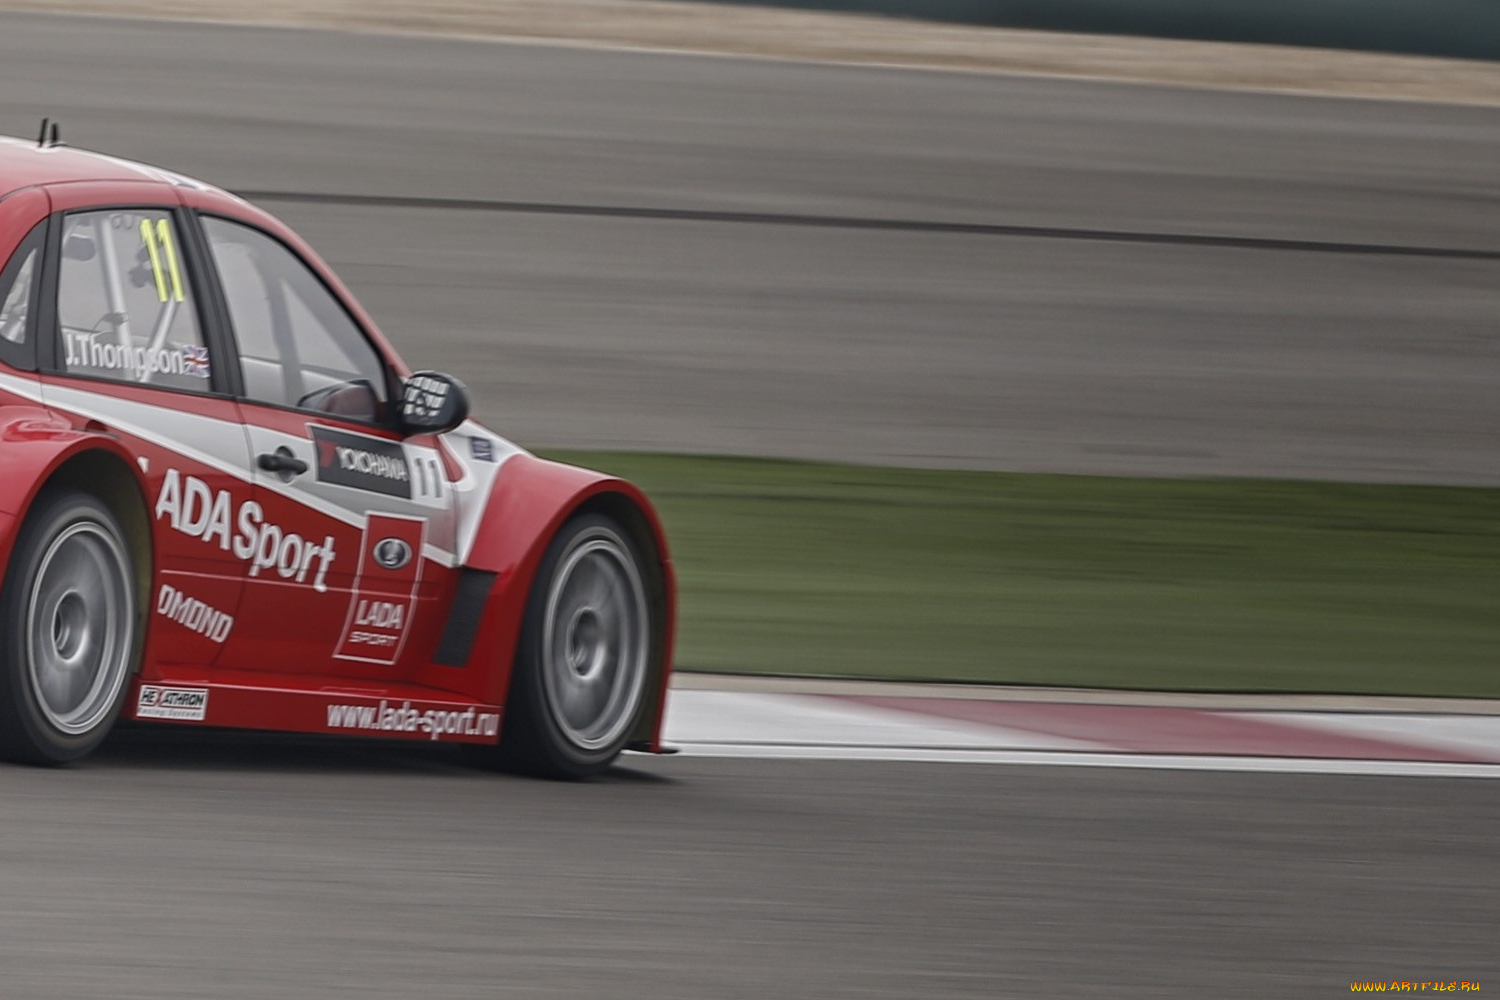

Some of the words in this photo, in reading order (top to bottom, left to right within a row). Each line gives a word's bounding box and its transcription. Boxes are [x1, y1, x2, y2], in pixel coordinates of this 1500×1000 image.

[140, 219, 184, 302] 11
[414, 457, 442, 498] 11
[232, 501, 336, 592] Sport
[355, 600, 404, 629] LADA
[349, 631, 399, 647] SPORT
[327, 700, 500, 740] www.lada-sport.ru
